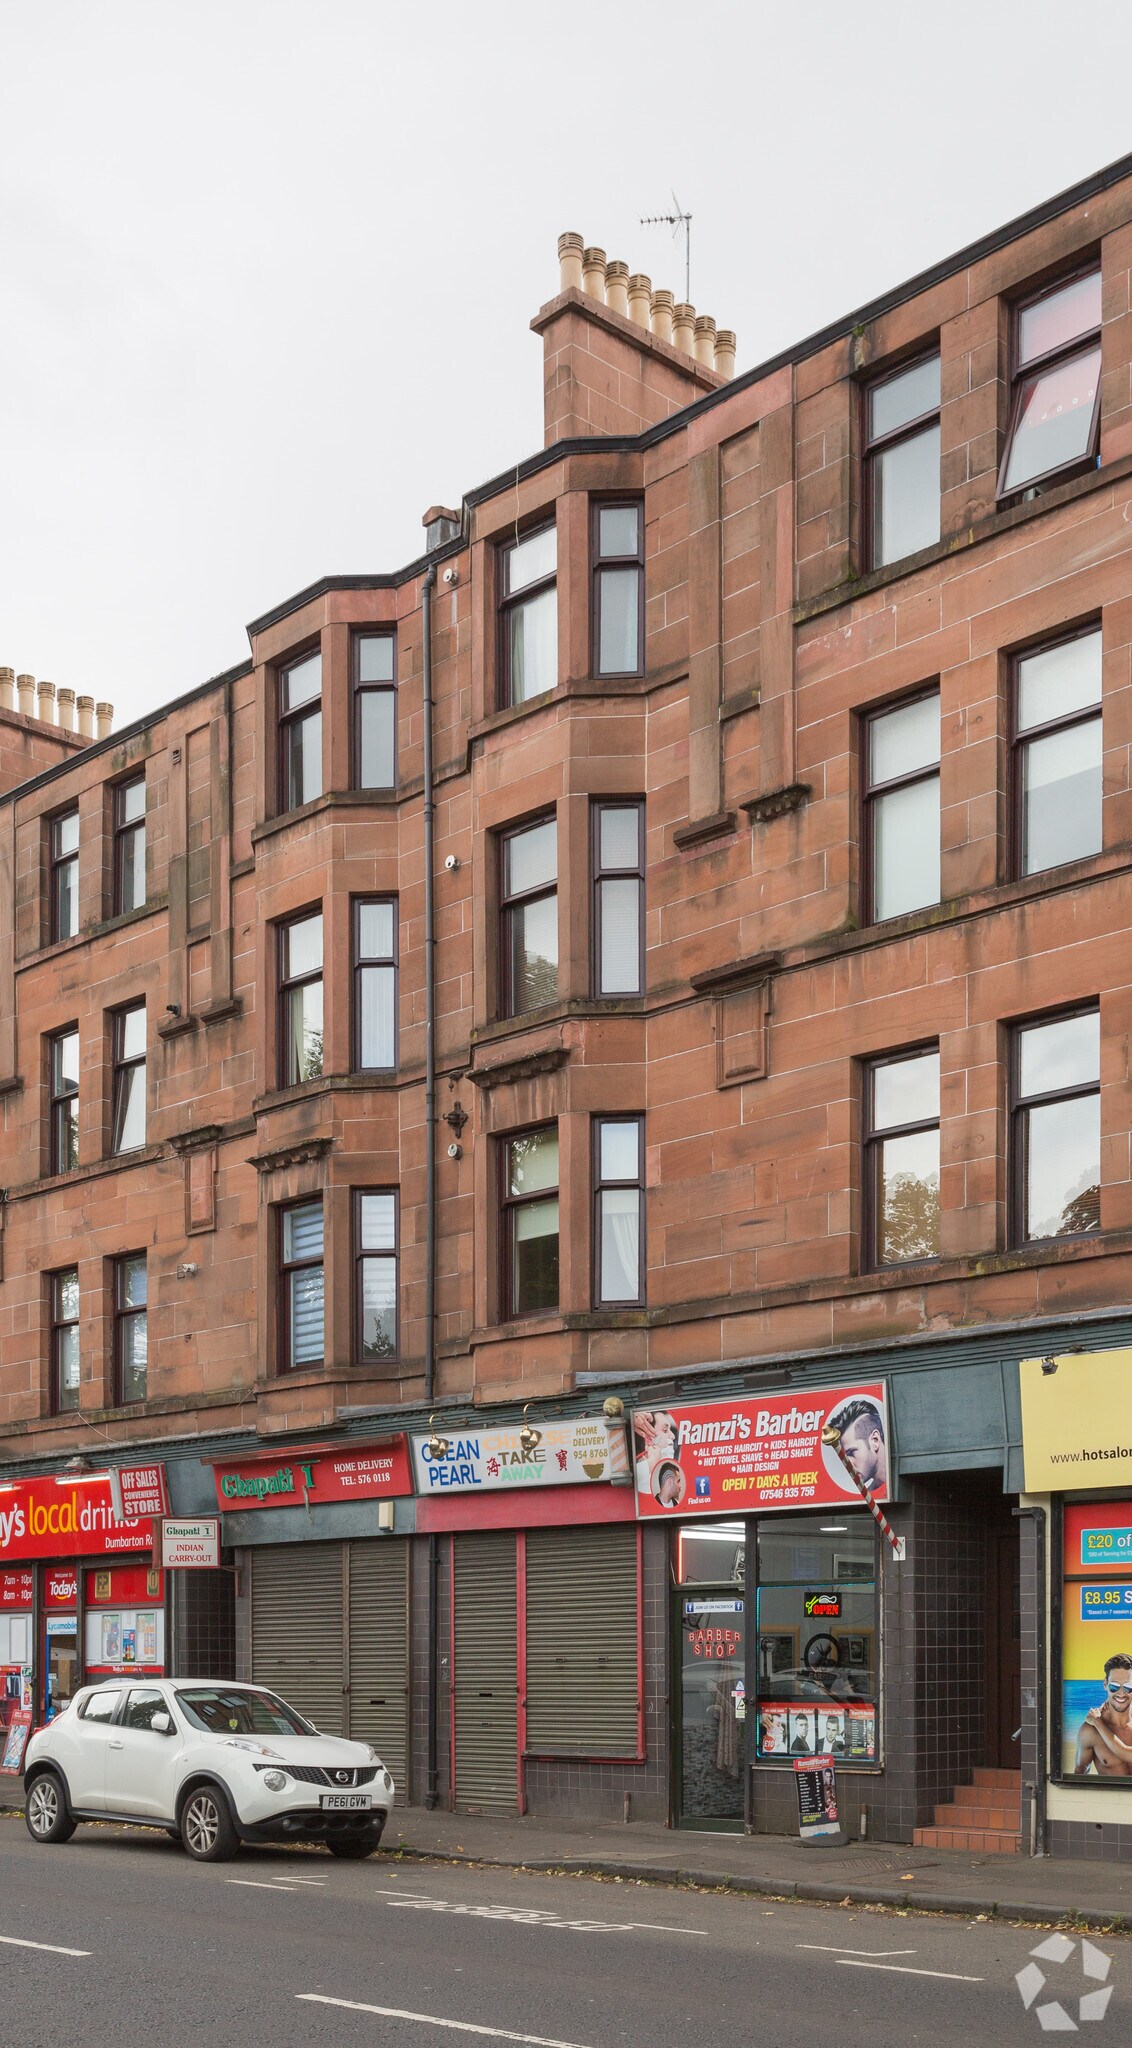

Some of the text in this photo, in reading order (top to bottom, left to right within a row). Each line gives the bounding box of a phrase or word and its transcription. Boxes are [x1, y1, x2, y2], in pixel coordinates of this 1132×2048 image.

[576, 1426, 598, 1436] HOME
[678, 1408, 824, 1445] Ramzi's Barber
[482, 1430, 571, 1451] CHISE
[573, 1436, 606, 1446] DELIVERY
[698, 1436, 818, 1457] ALL GENTS HAIRCUT KIDS HAIRCUT
[498, 1449, 546, 1465] TAKE
[574, 1449, 608, 1459] 954 8768
[704, 1448, 813, 1466] HOT TOWEL SHAVE HEAD SHAVE
[334, 1458, 394, 1473] HOME DELIVERY
[737, 1462, 779, 1473] HAIR DESIGN
[121, 1470, 158, 1489] OFF SALES
[341, 1472, 390, 1486] TEL: 576 0118
[429, 1464, 482, 1486] PEARL
[501, 1465, 544, 1481] AWAY
[722, 1472, 818, 1491] OPEN 7 DAYS A WEEK
[123, 1489, 160, 1500] CONVENIENCE
[760, 1486, 814, 1500] 07546 935 756
[29, 1491, 79, 1536] local
[124, 1499, 161, 1515] STORE
[105, 1536, 144, 1549] Dumbarton
[1088, 1535, 1112, 1548] £20
[4, 1575, 16, 1585] 7am
[4, 1590, 15, 1600] 8am
[50, 1580, 77, 1598] Today's
[1085, 1591, 1120, 1604] £8.95
[813, 1604, 838, 1614] OPEN
[689, 1629, 740, 1642] BARBER
[694, 1644, 735, 1657] SHOP
[328, 1797, 348, 1807] PE61
[387, 1900, 634, 1932] DISABLED
